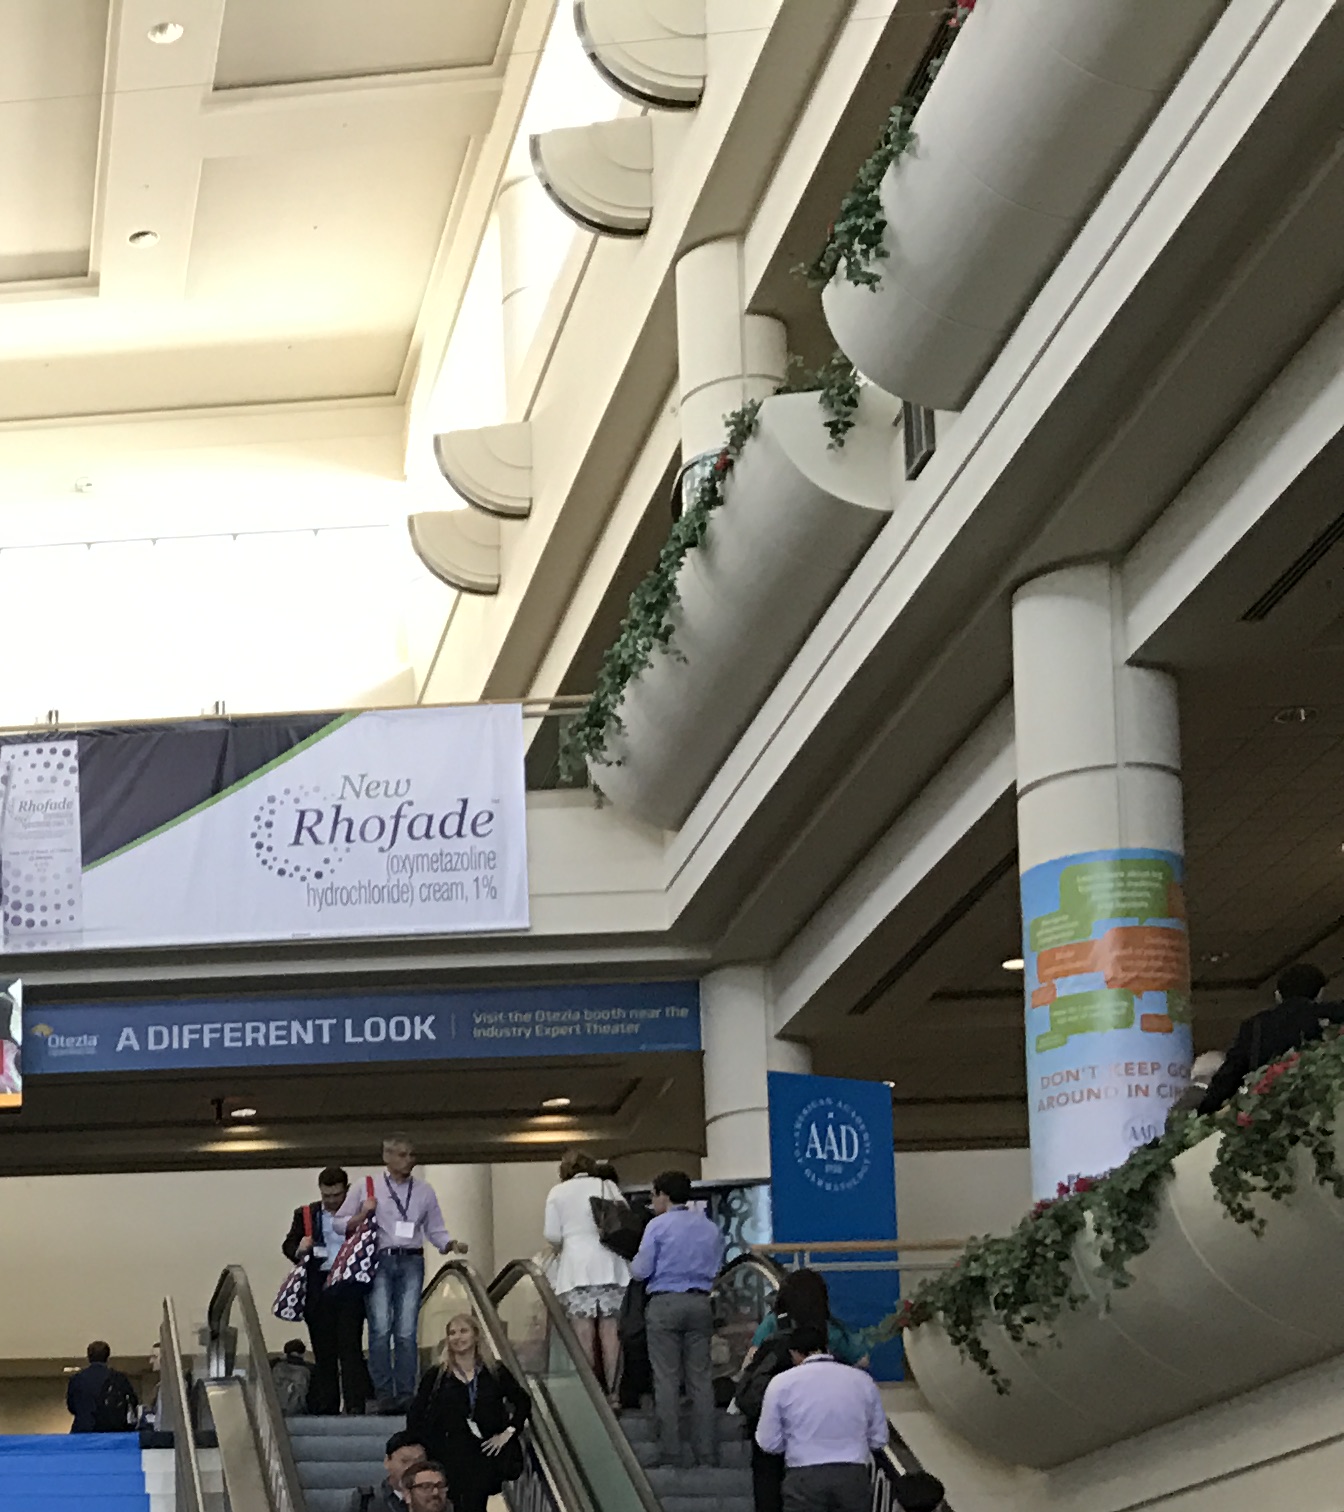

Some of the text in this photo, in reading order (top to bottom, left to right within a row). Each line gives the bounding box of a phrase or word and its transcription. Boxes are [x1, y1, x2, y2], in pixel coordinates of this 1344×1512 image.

[338, 773, 412, 801] New
[17, 797, 74, 813] Rhofade
[287, 797, 497, 853] Rhofade
[385, 847, 498, 881] (oxymetazoline
[306, 875, 498, 912] hydrochloride) cream, 1%
[472, 1006, 689, 1024] Visit the Otezla booth near the
[47, 1034, 99, 1049] Otezla
[115, 1014, 437, 1052] A DIFFERENT LOOK
[472, 1022, 642, 1041] Industry Expert Theater
[1039, 1064, 1099, 1090] DON'T
[1037, 1085, 1119, 1112] AROUND
[1127, 1084, 1150, 1098] IN
[805, 1121, 859, 1162] AAD
